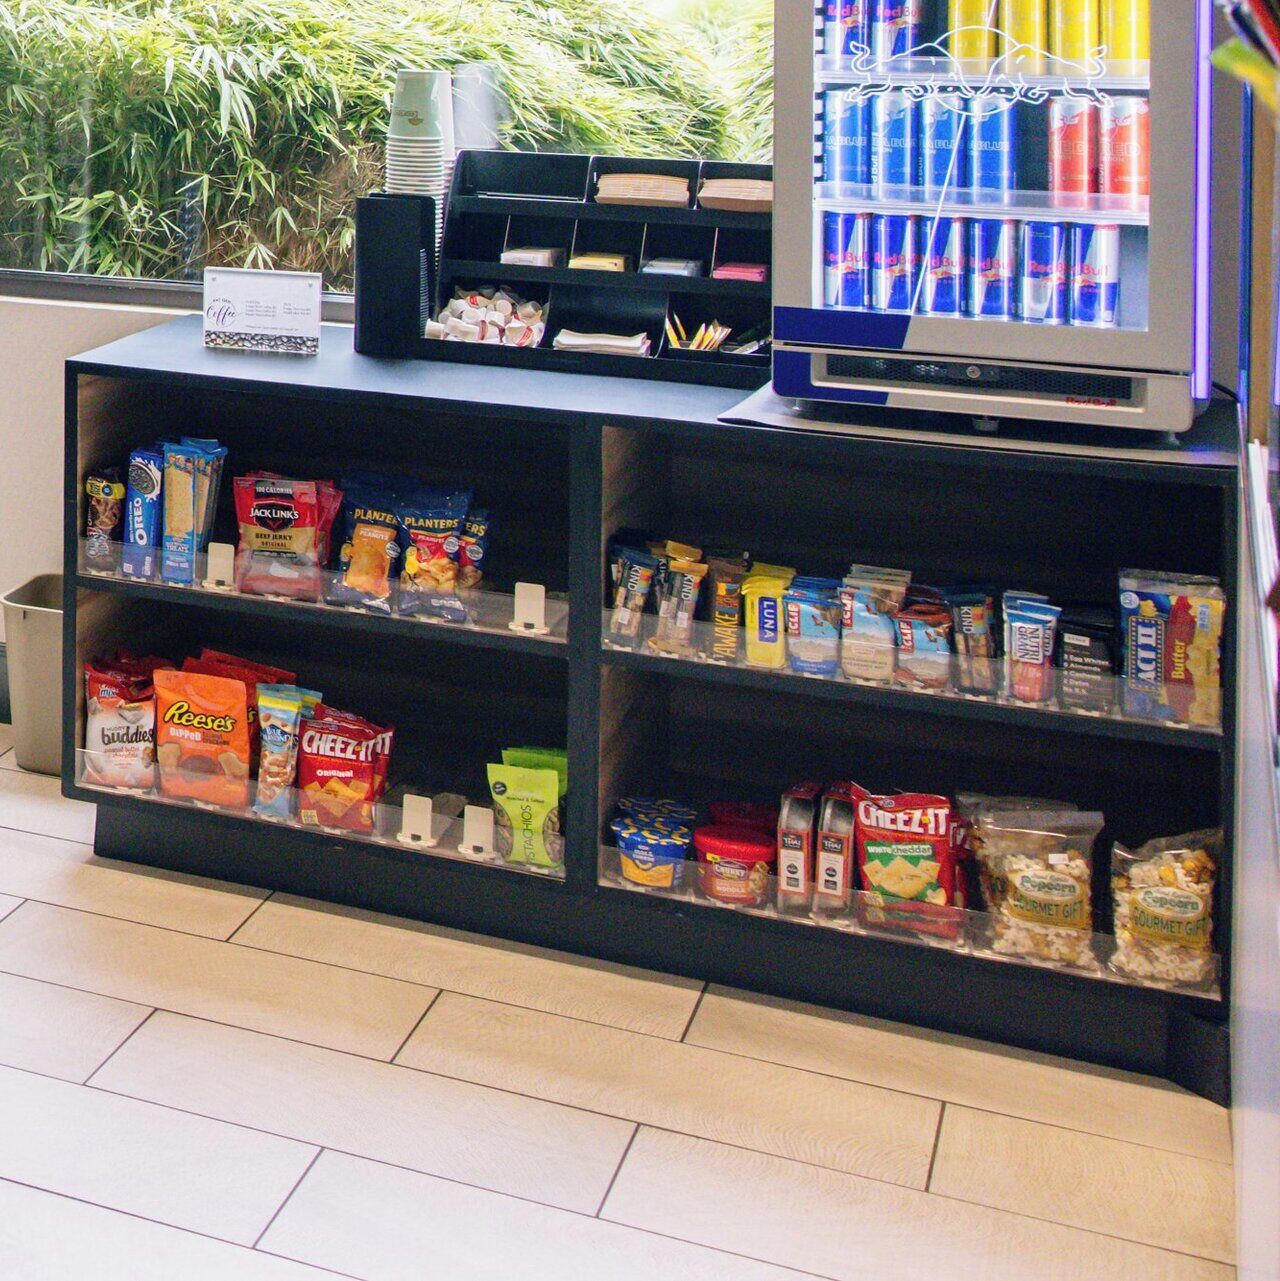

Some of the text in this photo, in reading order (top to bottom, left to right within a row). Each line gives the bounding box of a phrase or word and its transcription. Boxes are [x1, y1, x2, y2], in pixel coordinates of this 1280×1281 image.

[206, 305, 237, 327] Coffee
[133, 497, 148, 546] OREO
[249, 507, 271, 519] JACK
[404, 516, 460, 529] PLANTERS
[255, 532, 293, 541] BEEF JERKY
[627, 563, 642, 592] KIND
[681, 573, 696, 601] KIND
[712, 610, 739, 659] AWAKE
[762, 600, 776, 640] LUNA
[960, 605, 974, 635] KIND
[1017, 625, 1029, 660] GRAIN
[1028, 626, 1040, 662] NUTRI
[1137, 645, 1157, 684] ACT
[1171, 639, 1187, 680] Butter
[164, 701, 237, 733] Reese's
[101, 725, 155, 746] buddies
[302, 729, 376, 762] CHEEZ-IT
[858, 800, 950, 836] CHEEZ-IT
[892, 844, 933, 856] cheddar
[1020, 875, 1078, 896] Popcorn
[1062, 901, 1083, 920] GIFT
[1141, 889, 1201, 912] Popcorn
